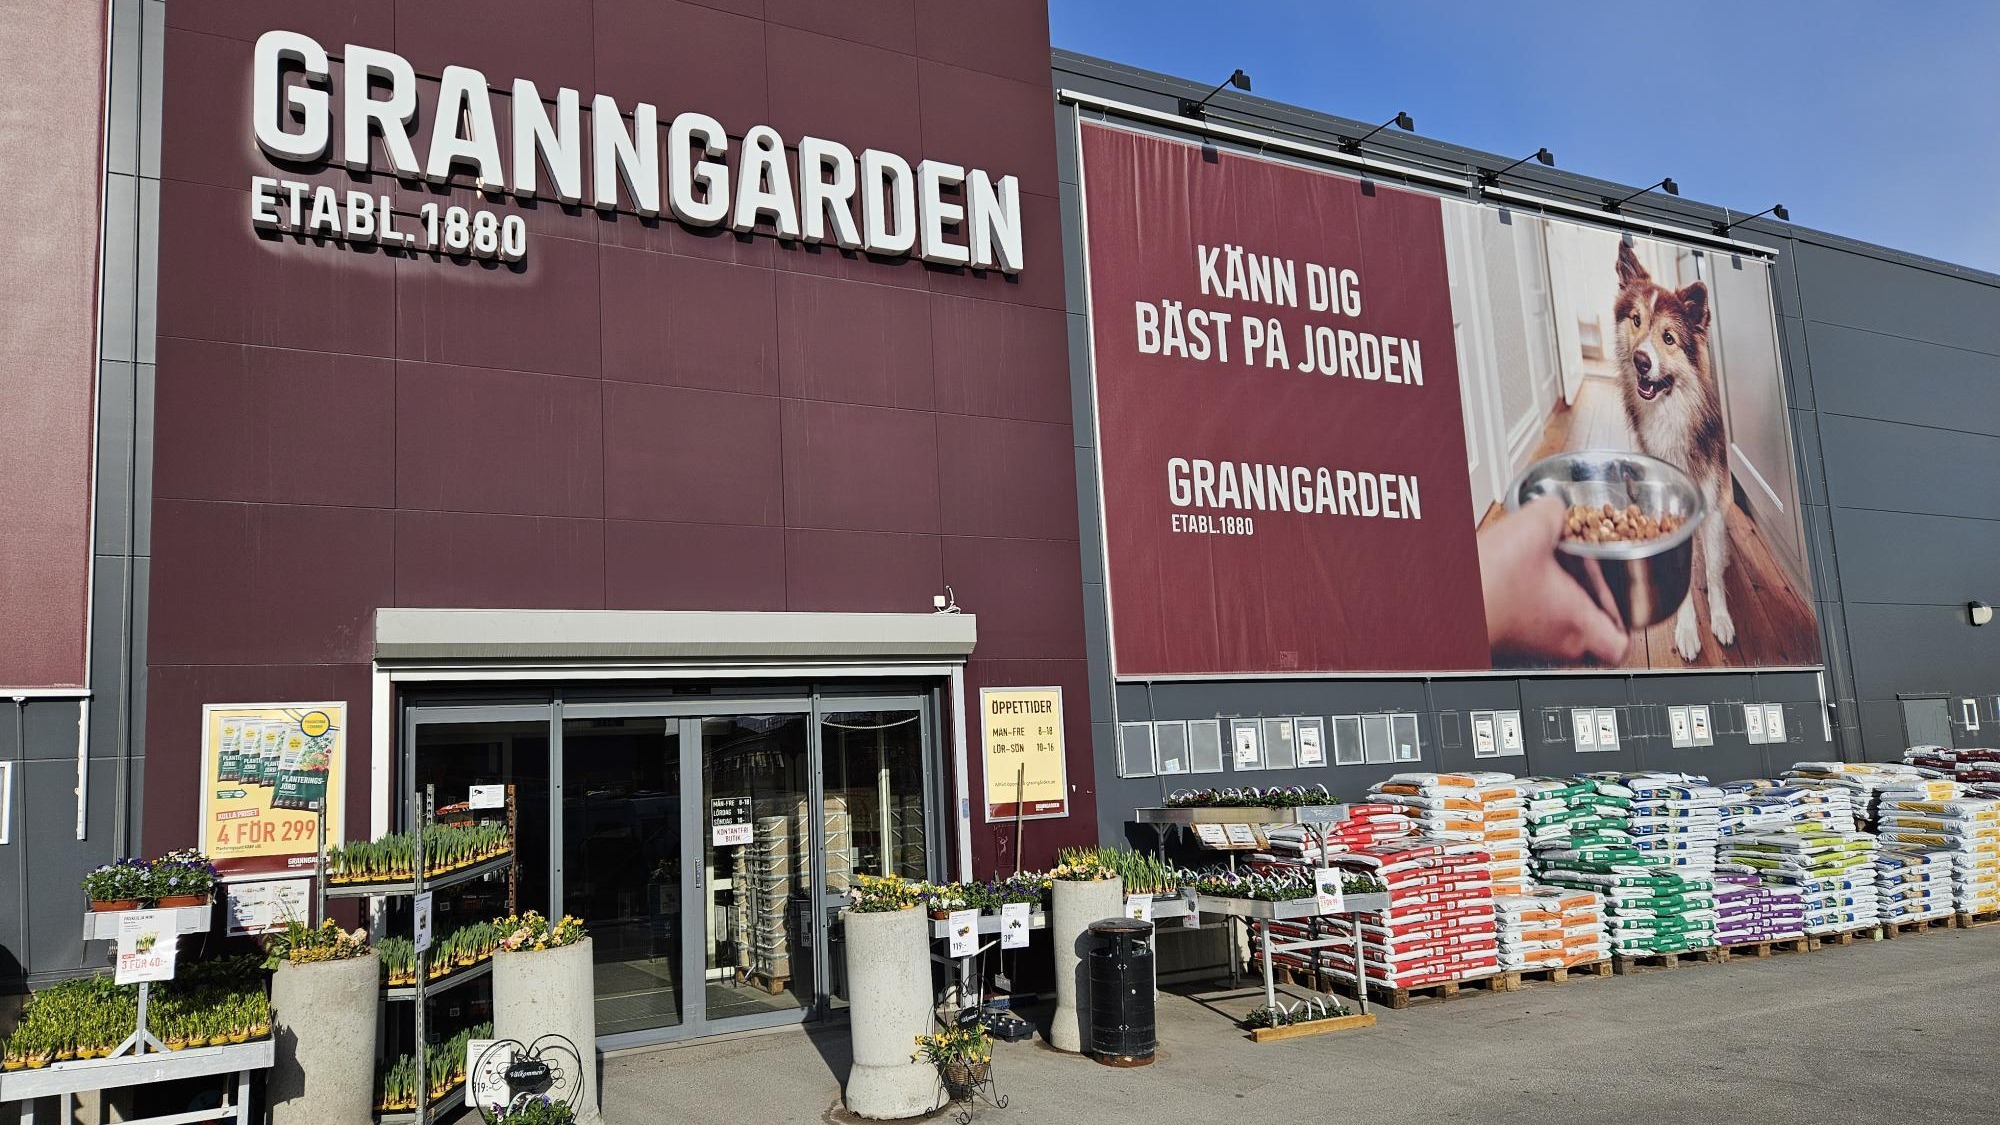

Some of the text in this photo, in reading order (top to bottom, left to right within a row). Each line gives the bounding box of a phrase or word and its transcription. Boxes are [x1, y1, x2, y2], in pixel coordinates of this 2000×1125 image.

[253, 30, 1023, 274] GRANNGÅRDEN
[1197, 243, 1362, 318] KÄNN DIG
[1135, 299, 1424, 386] BÄST PÅ JORDEN
[1167, 457, 1422, 520] GRANNGÅRDEN
[992, 699, 1052, 715] ÖPPETTIDER
[281, 775, 325, 785] PLANTERINGS-
[280, 782, 296, 790] JORD
[713, 808, 732, 817] LÖRDAG
[713, 817, 733, 826] SÖNDAG
[217, 824, 230, 845] 4
[237, 820, 276, 844] FÖR
[717, 827, 749, 836] KONTANTFRI
[725, 835, 741, 843] BUTIK
[121, 960, 127, 970] 3
[130, 958, 147, 970] FÖR
[509, 1069, 543, 1079] Välkommen
